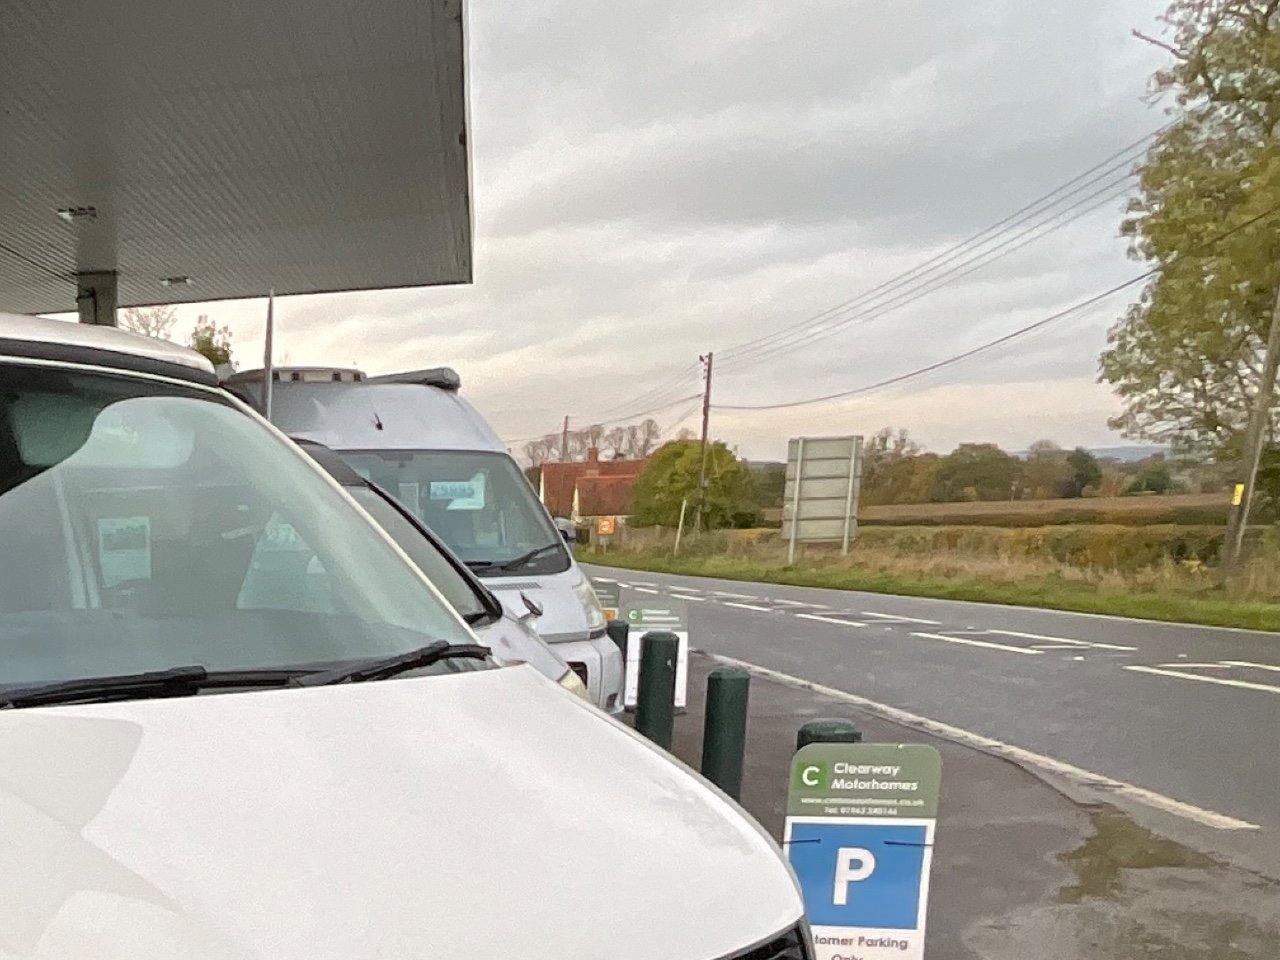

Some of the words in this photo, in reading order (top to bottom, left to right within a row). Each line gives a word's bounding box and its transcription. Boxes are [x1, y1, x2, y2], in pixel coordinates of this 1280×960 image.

[802, 766, 820, 786] C
[834, 762, 901, 777] Clearway
[831, 779, 918, 791] Motorhomes
[833, 847, 876, 905] P
[858, 936, 908, 951] Parking
